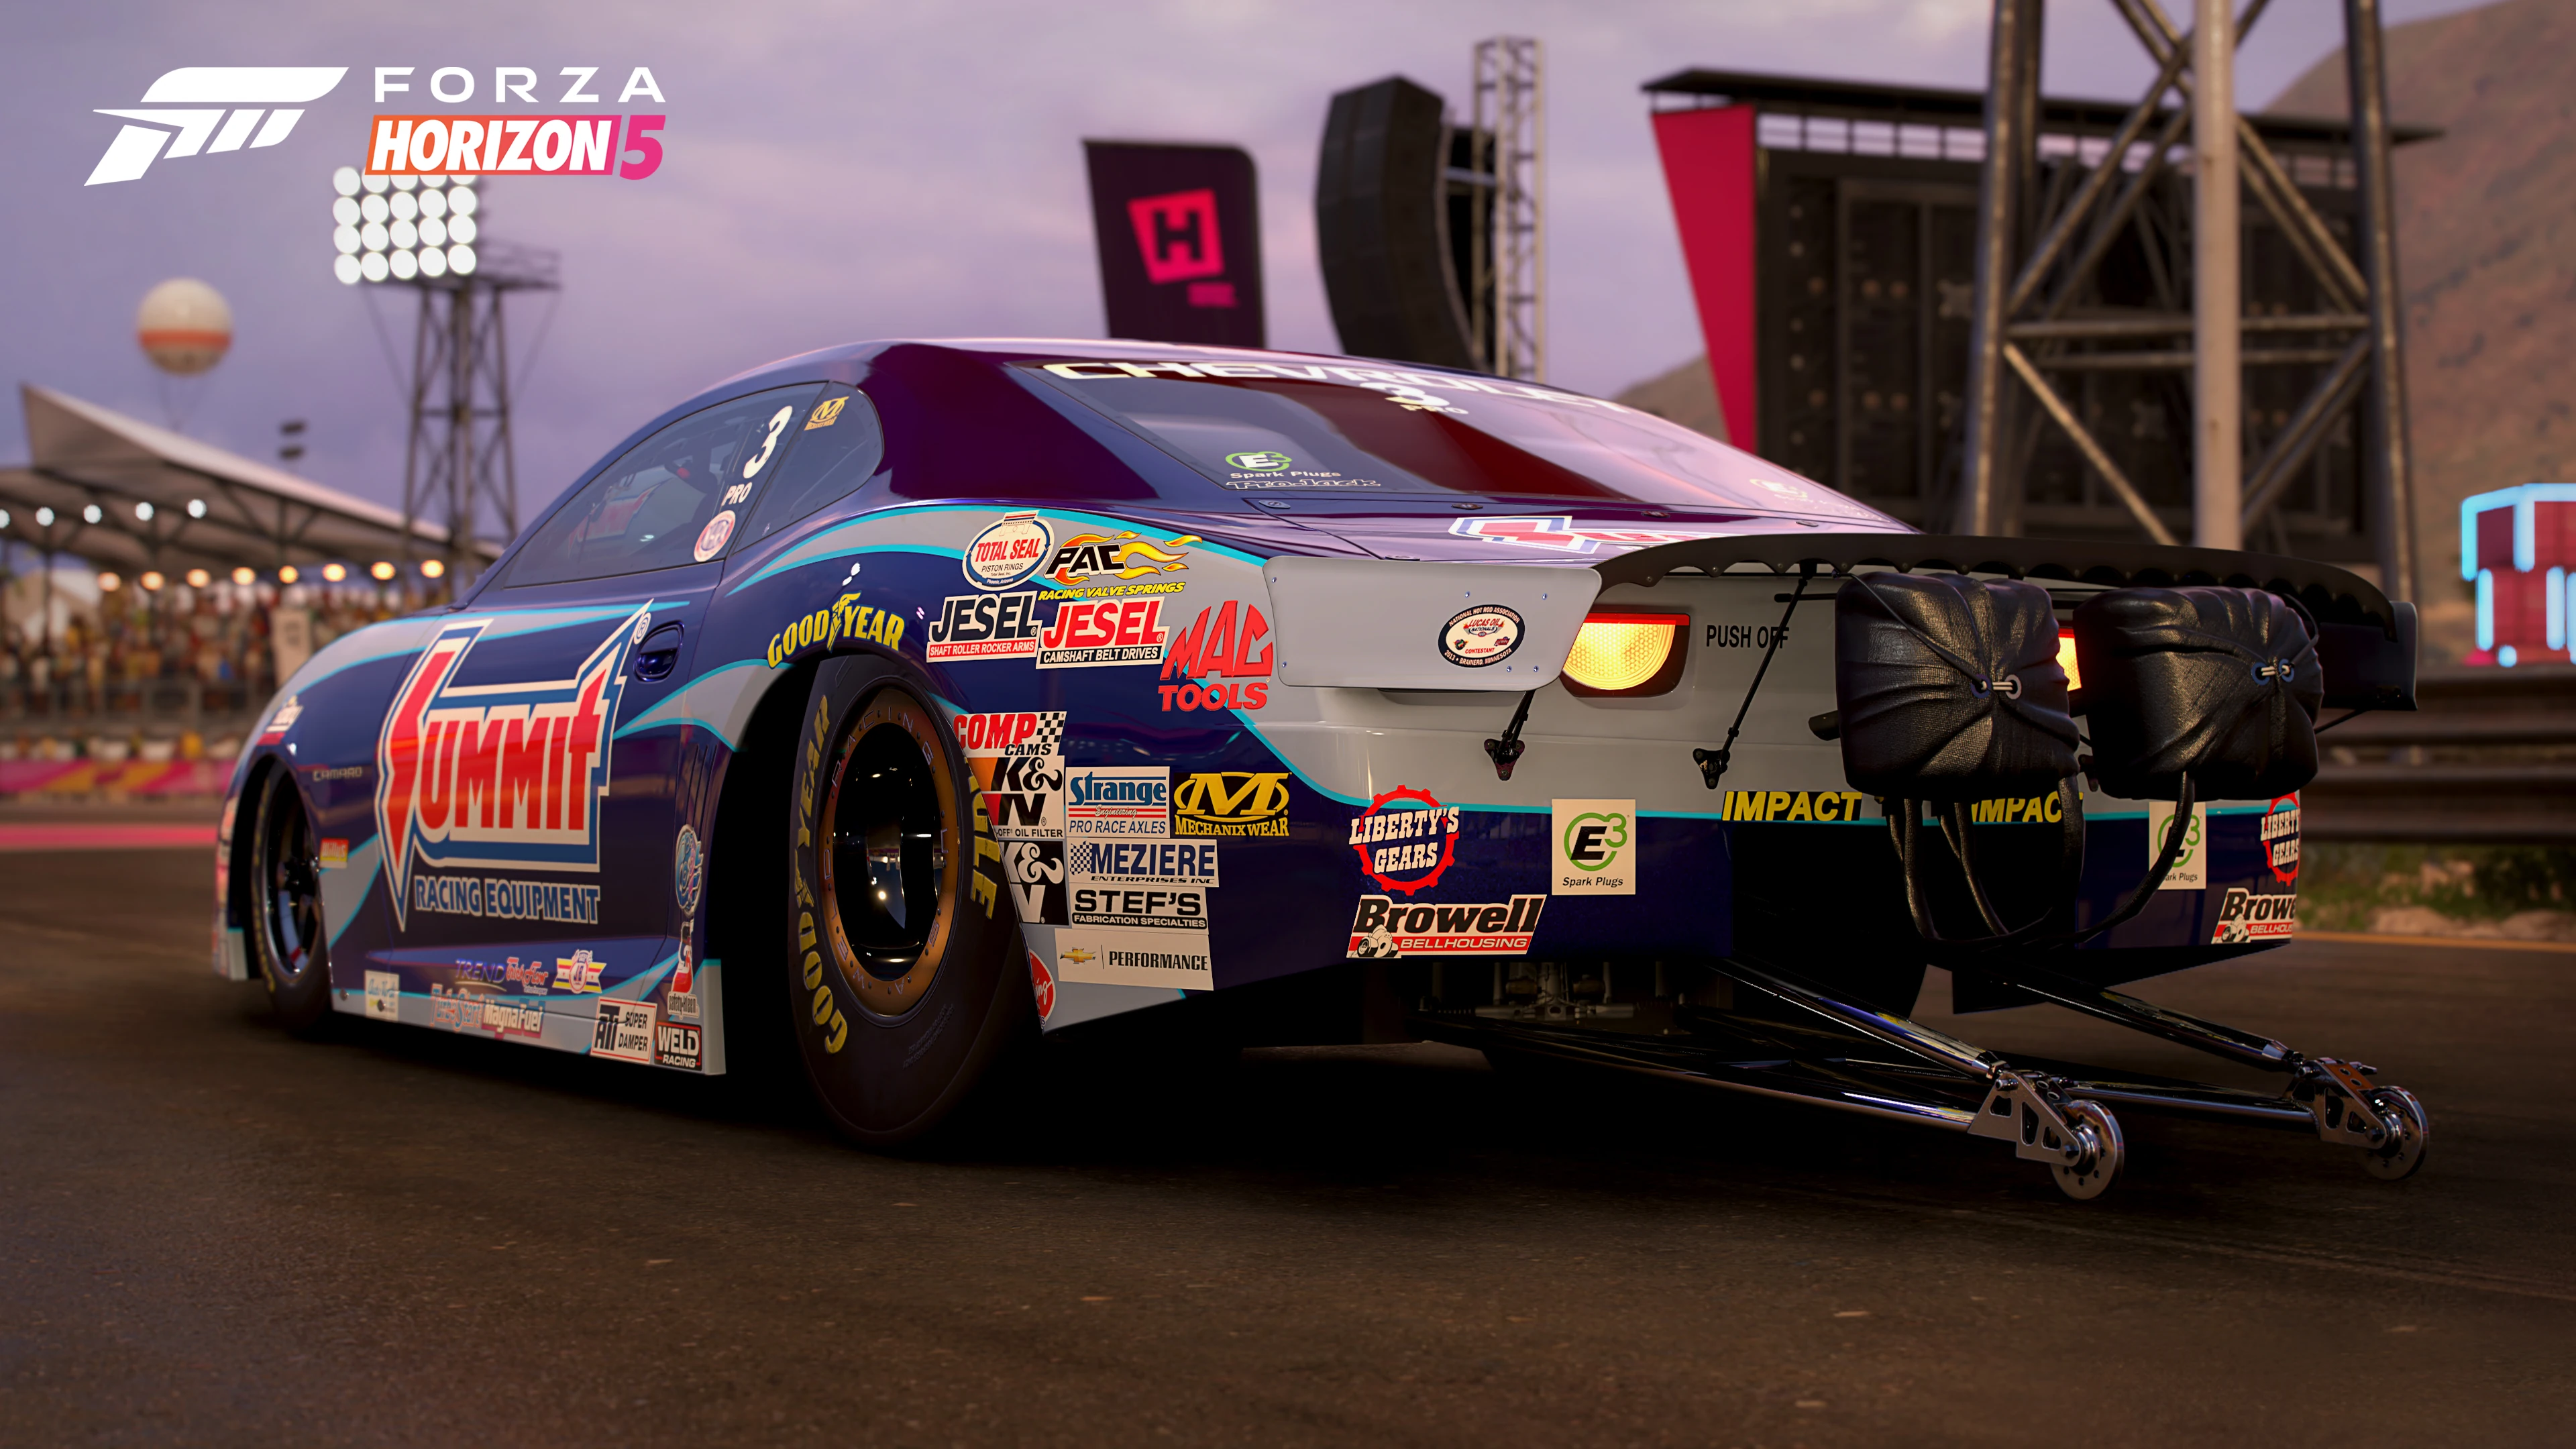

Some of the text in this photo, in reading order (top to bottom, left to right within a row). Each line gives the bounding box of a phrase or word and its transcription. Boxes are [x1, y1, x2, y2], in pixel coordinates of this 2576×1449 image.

[1043, 362, 1630, 414] CHEVROLET
[743, 405, 793, 479] 3
[1230, 470, 1284, 479] Spark
[721, 482, 753, 506] PRO
[975, 537, 1041, 564] TOTAL SEAL
[1044, 543, 1126, 579] PAC
[981, 563, 1024, 572] PISTON RINGS
[1038, 582, 1186, 601] RACING VALVE SPRINGS
[931, 600, 1037, 642] JESEL
[1043, 600, 1164, 649] JESEL
[1449, 610, 1472, 627] NATIONAL
[1493, 606, 1520, 624] ASSOCIATION
[1468, 618, 1501, 627] LUCAS OIL
[767, 591, 905, 669] GOODYEAR
[1160, 600, 1273, 681] MAC
[1706, 625, 1752, 648] PUSH
[930, 641, 1034, 657] SHAFT ROLLER ROCKER ARMS
[1043, 647, 1159, 664] CAMSHAFT BELT DRIVES
[1444, 649, 1455, 661] 2013
[1485, 648, 1512, 665] MINNESOTA
[1158, 682, 1269, 712] TOOLS
[953, 713, 1038, 750] COMP
[382, 639, 621, 876] SUMMIT
[1004, 743, 1053, 756] CAMS
[313, 767, 363, 782] CAMARO
[1069, 771, 1167, 806] Strange
[1095, 804, 1138, 820] Engineering
[1722, 791, 1863, 821] IMPACT
[1972, 791, 2084, 823] IMPAC
[1015, 828, 1029, 837] OIL
[1031, 829, 1063, 838] FILTER
[1069, 820, 1166, 835] PRO RACE AXLES
[1175, 814, 1290, 837] MECHANIX WEAR
[1348, 806, 1460, 845] LIBERTY'S
[1091, 843, 1216, 877] MEZIERE
[1374, 841, 1438, 873] GEARS
[1091, 875, 1188, 884] ENTERPRISES
[1562, 877, 1623, 888] Spark Plugs
[2179, 872, 2198, 883] Plugs
[414, 875, 600, 924] RACING EQUIPMENT
[1075, 889, 1201, 916] STEF'S
[1074, 914, 1206, 928] FABRICATION SPECIALTIES
[1352, 898, 1545, 934] Browell
[1400, 938, 1527, 949] BELLHOUSING
[455, 959, 506, 984] TREND
[1109, 951, 1208, 971] PERFORMANCE
[625, 1012, 649, 1030] SUPER
[618, 1033, 649, 1052] DAMPER
[657, 1026, 700, 1057] WELD
[662, 1054, 696, 1068] RACING
